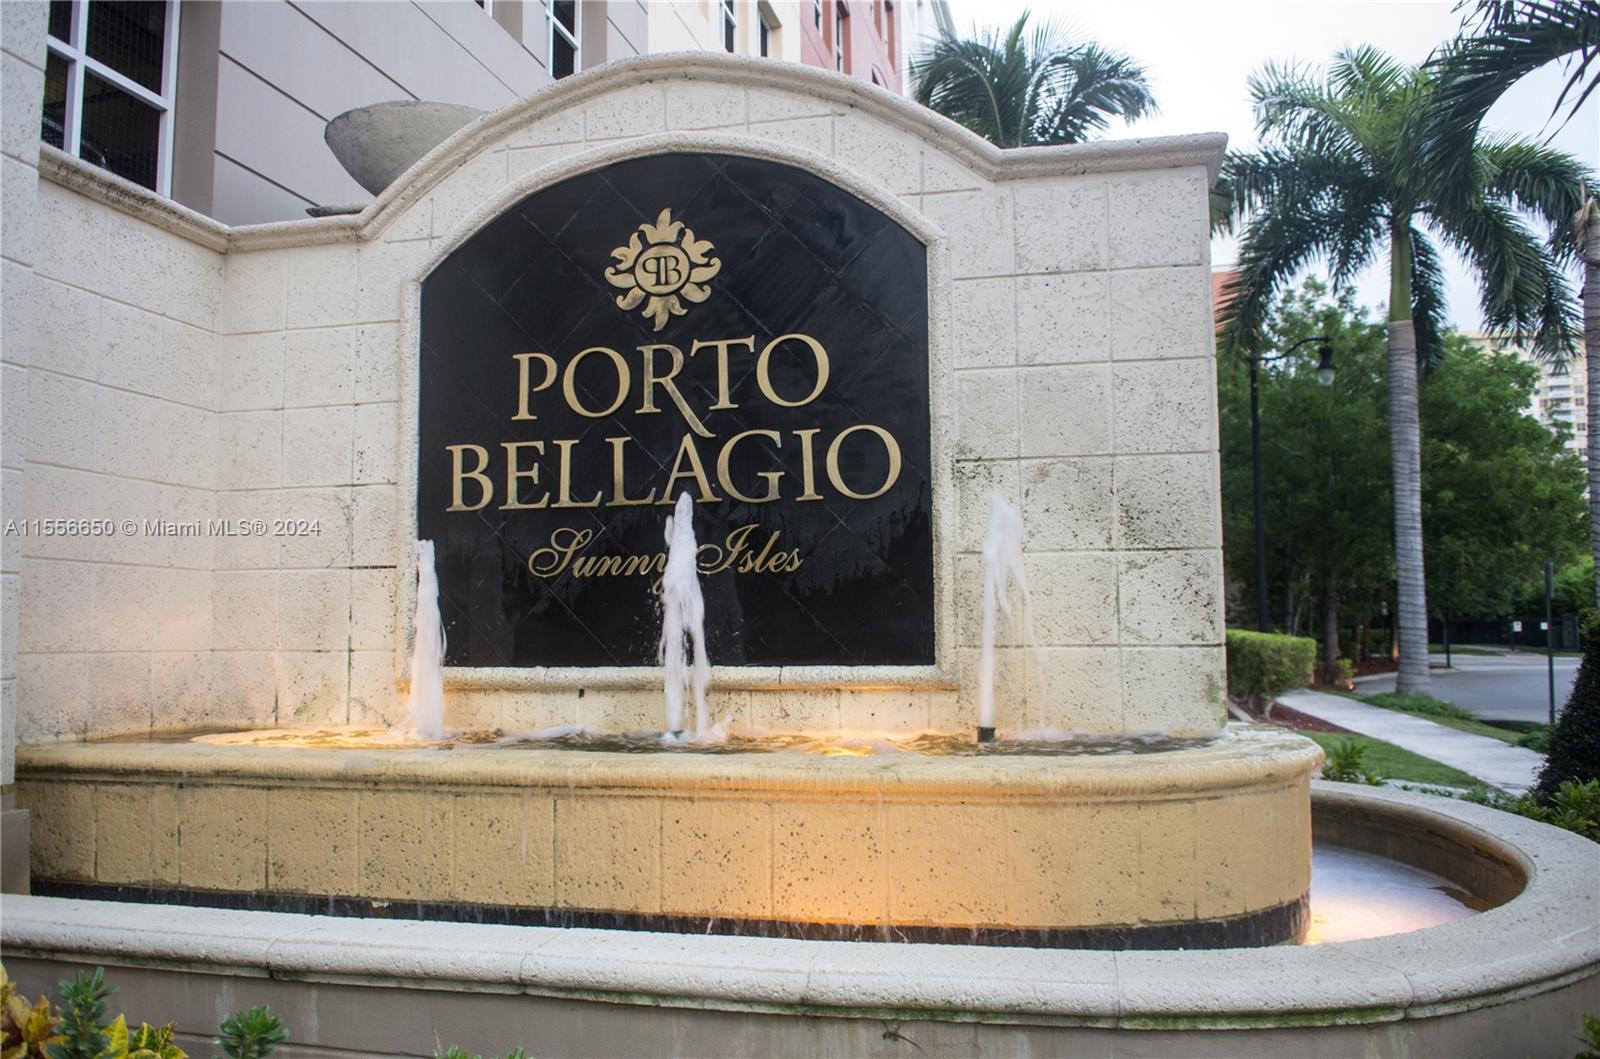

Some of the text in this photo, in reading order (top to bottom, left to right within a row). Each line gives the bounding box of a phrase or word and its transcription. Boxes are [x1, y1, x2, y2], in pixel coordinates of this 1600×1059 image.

[510, 333, 830, 439] PORTO
[445, 424, 902, 513] BELLAGIO
[696, 523, 804, 575] Isles
